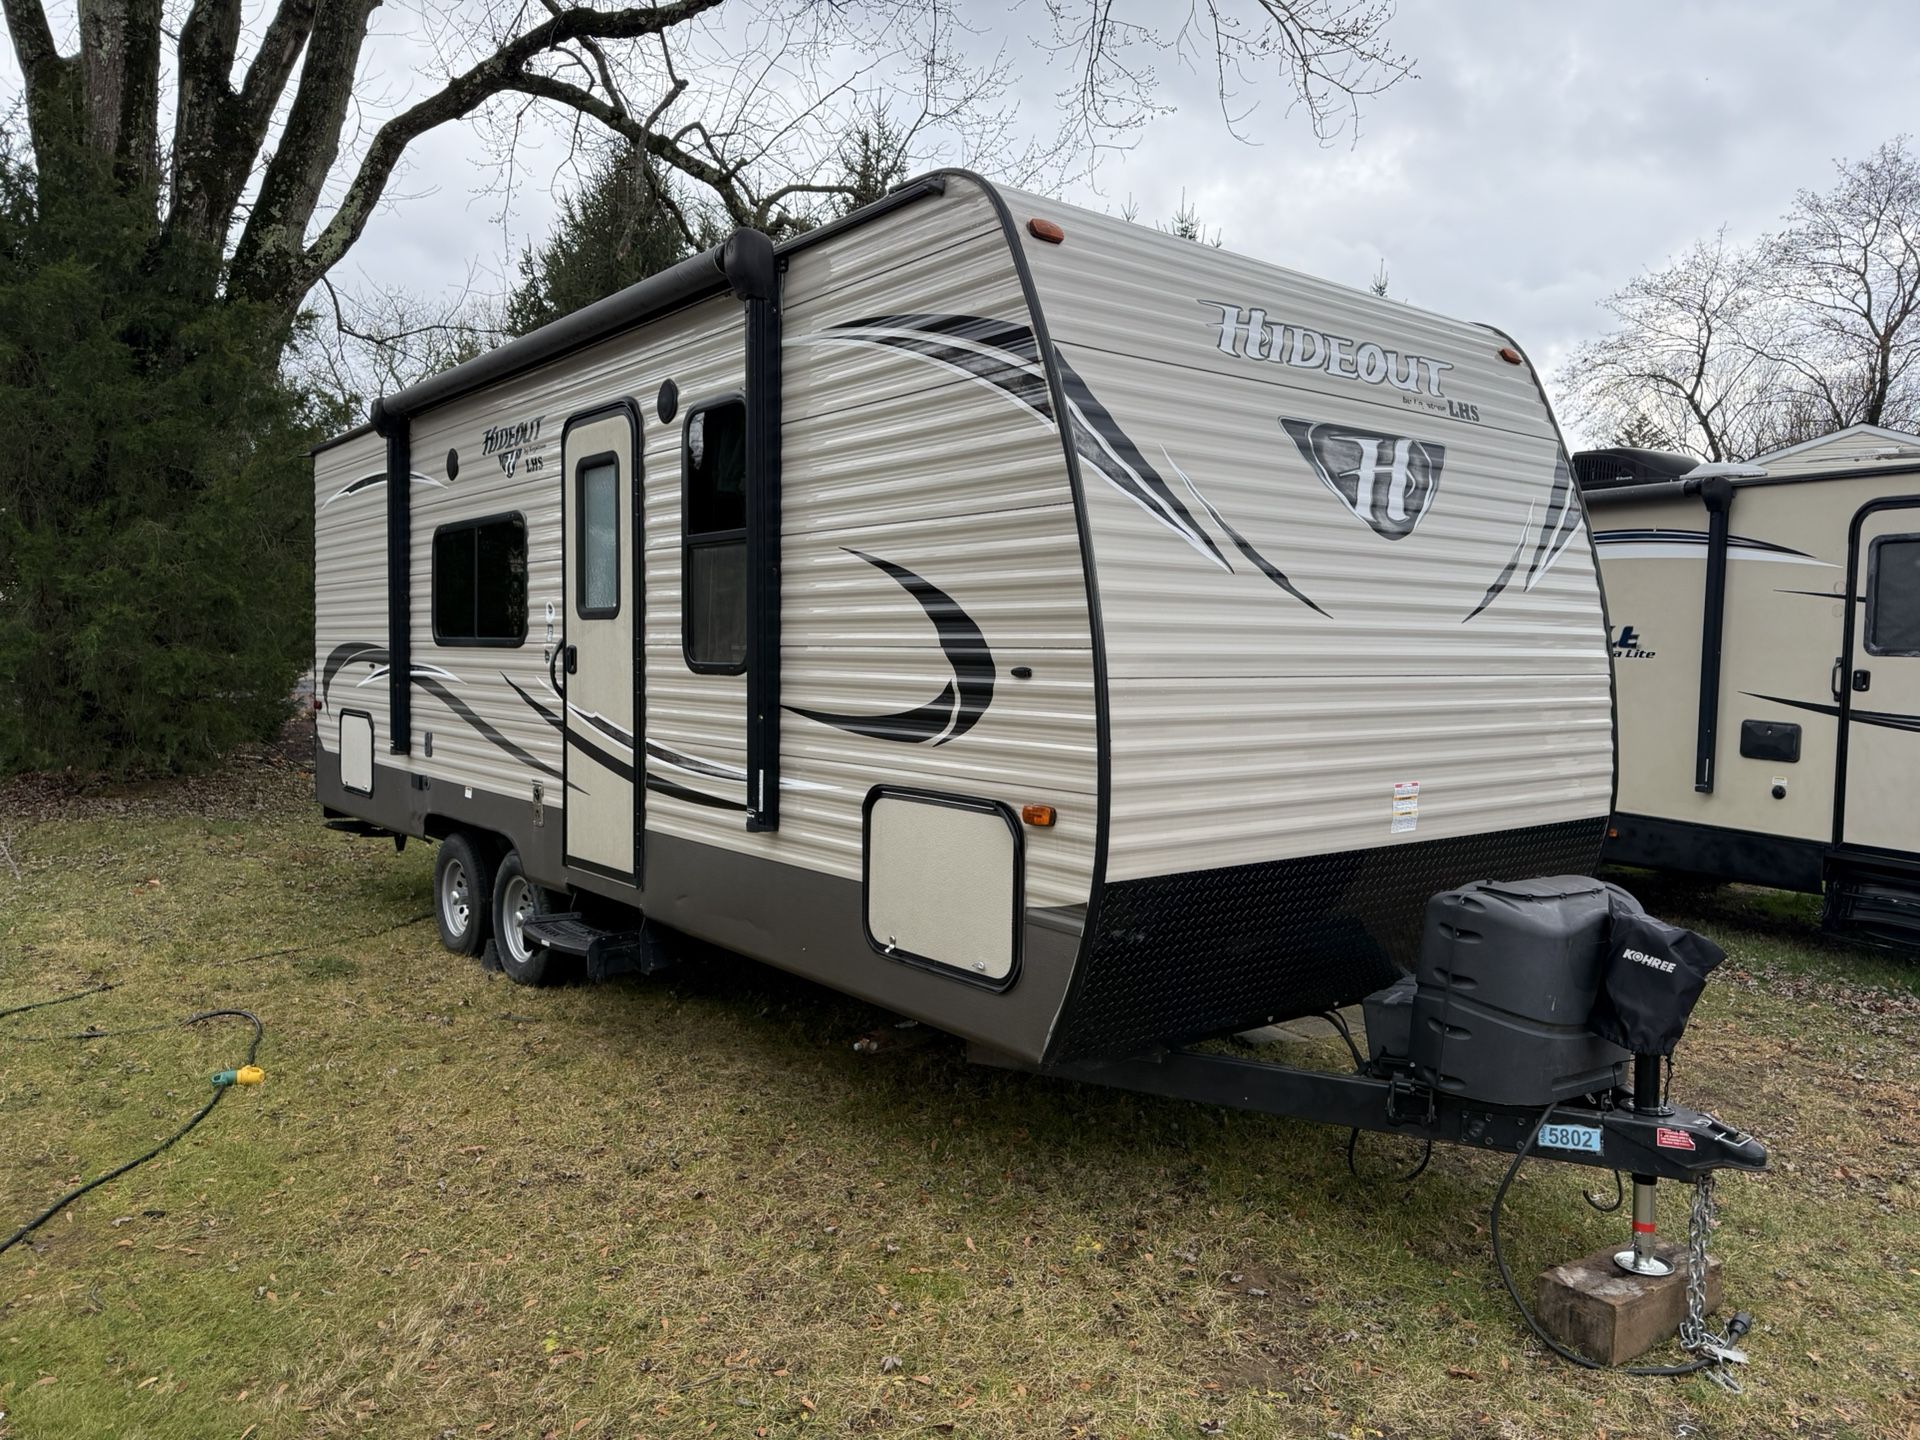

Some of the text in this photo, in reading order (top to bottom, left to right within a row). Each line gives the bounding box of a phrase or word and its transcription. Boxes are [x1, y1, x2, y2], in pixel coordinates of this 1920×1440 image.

[1197, 299, 1454, 397] HIDEOUT
[1447, 399, 1480, 422] LHS
[482, 415, 546, 456] HIDEOUT
[525, 456, 544, 473] LHS
[1328, 435, 1417, 523] H
[1625, 649, 1656, 659] Lite
[1622, 948, 1677, 973] KOHREE
[1548, 1127, 1593, 1148] 5802
